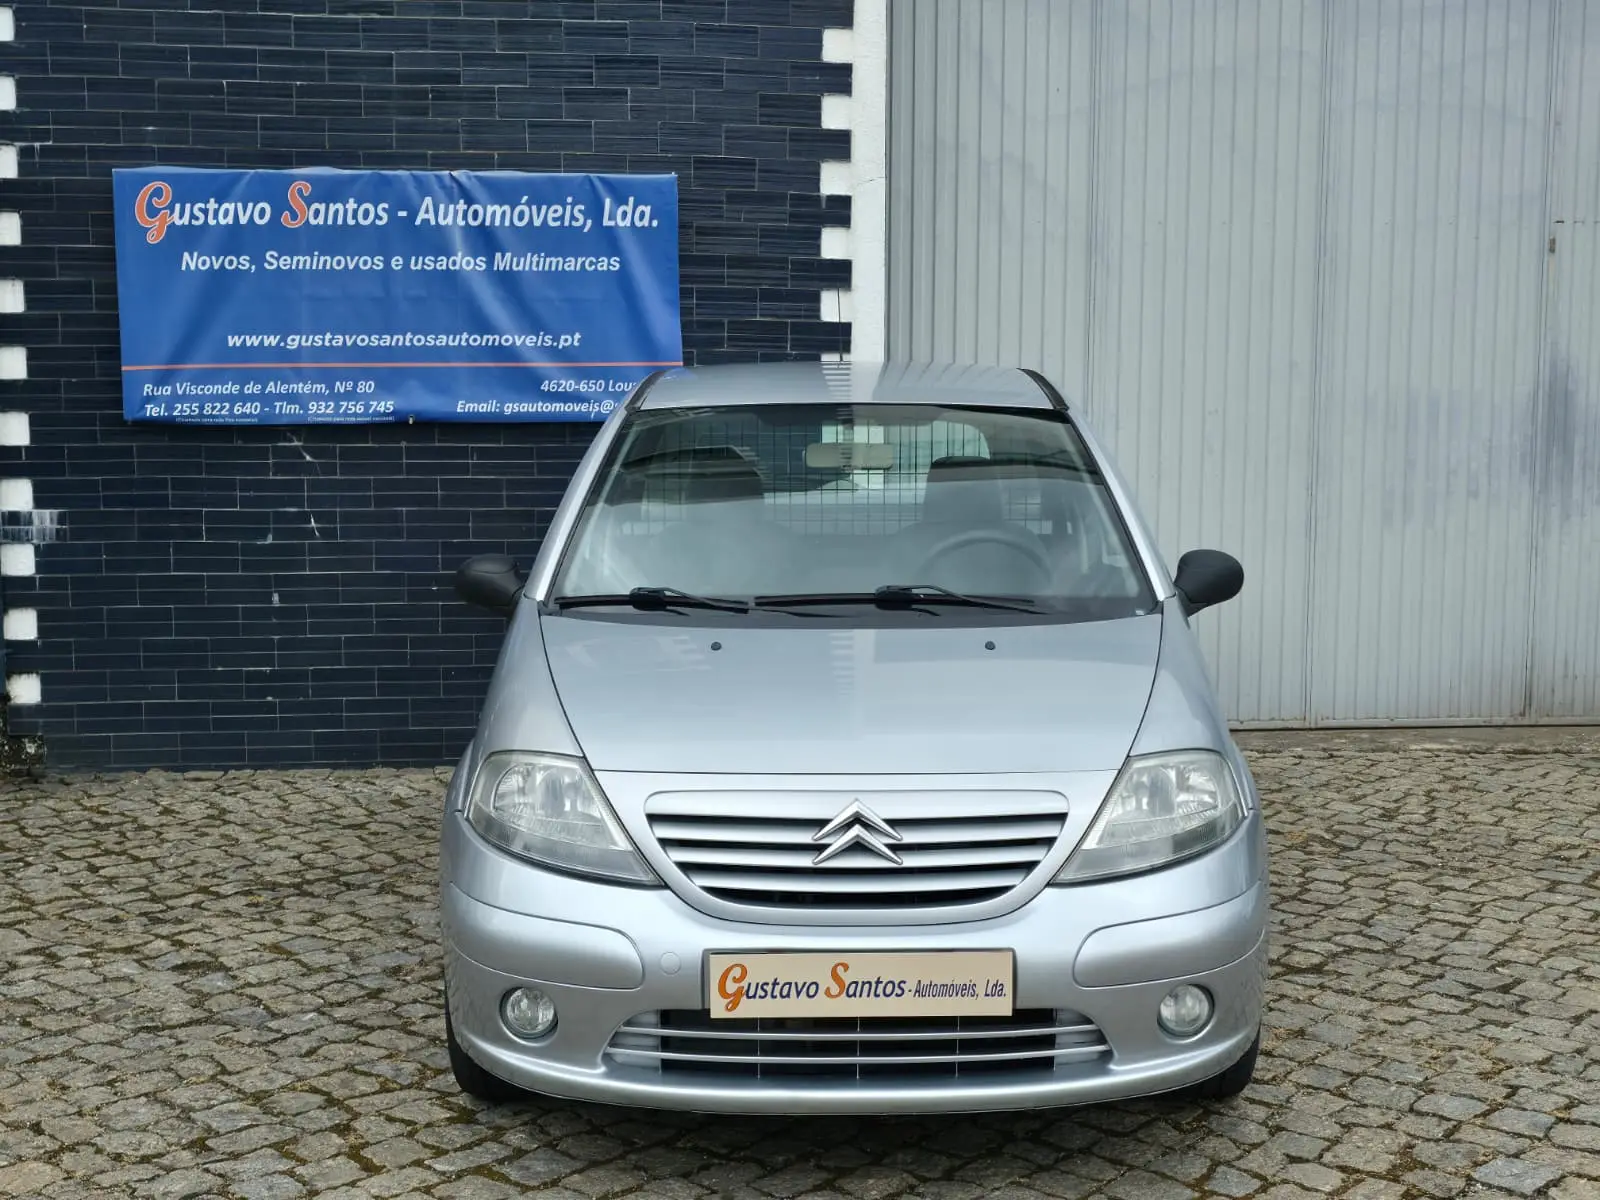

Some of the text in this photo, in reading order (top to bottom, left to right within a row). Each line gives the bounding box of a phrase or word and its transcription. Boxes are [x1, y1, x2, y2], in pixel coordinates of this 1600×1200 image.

[135, 181, 272, 244] Gustavo
[281, 181, 389, 228] Santos
[415, 196, 593, 232] Automóveis,
[602, 196, 659, 227] Lda.
[181, 250, 621, 272] Novos, Seminovos e usados Multimarcas
[227, 331, 582, 349] www.gustavosantosautomoveis.pt
[143, 383, 172, 396] Rua
[176, 381, 240, 396] Visconde
[244, 381, 262, 395] de
[265, 380, 330, 396] Alentém,
[356, 381, 375, 394] 80
[540, 379, 637, 392] 4620-650 Lou
[144, 404, 168, 417] Tel.
[173, 403, 199, 416] 255
[203, 402, 230, 415] 822
[233, 402, 261, 415] 640
[274, 402, 303, 414] Tlm.
[307, 401, 334, 414] 932
[339, 401, 364, 414] 756
[368, 400, 394, 413] 745
[456, 399, 618, 415] Email: gsautomoveis@
[718, 963, 819, 1012] Gustavo
[824, 962, 907, 999] Santos
[913, 979, 979, 1000] Automóveis,
[984, 980, 1007, 998] Lda.
